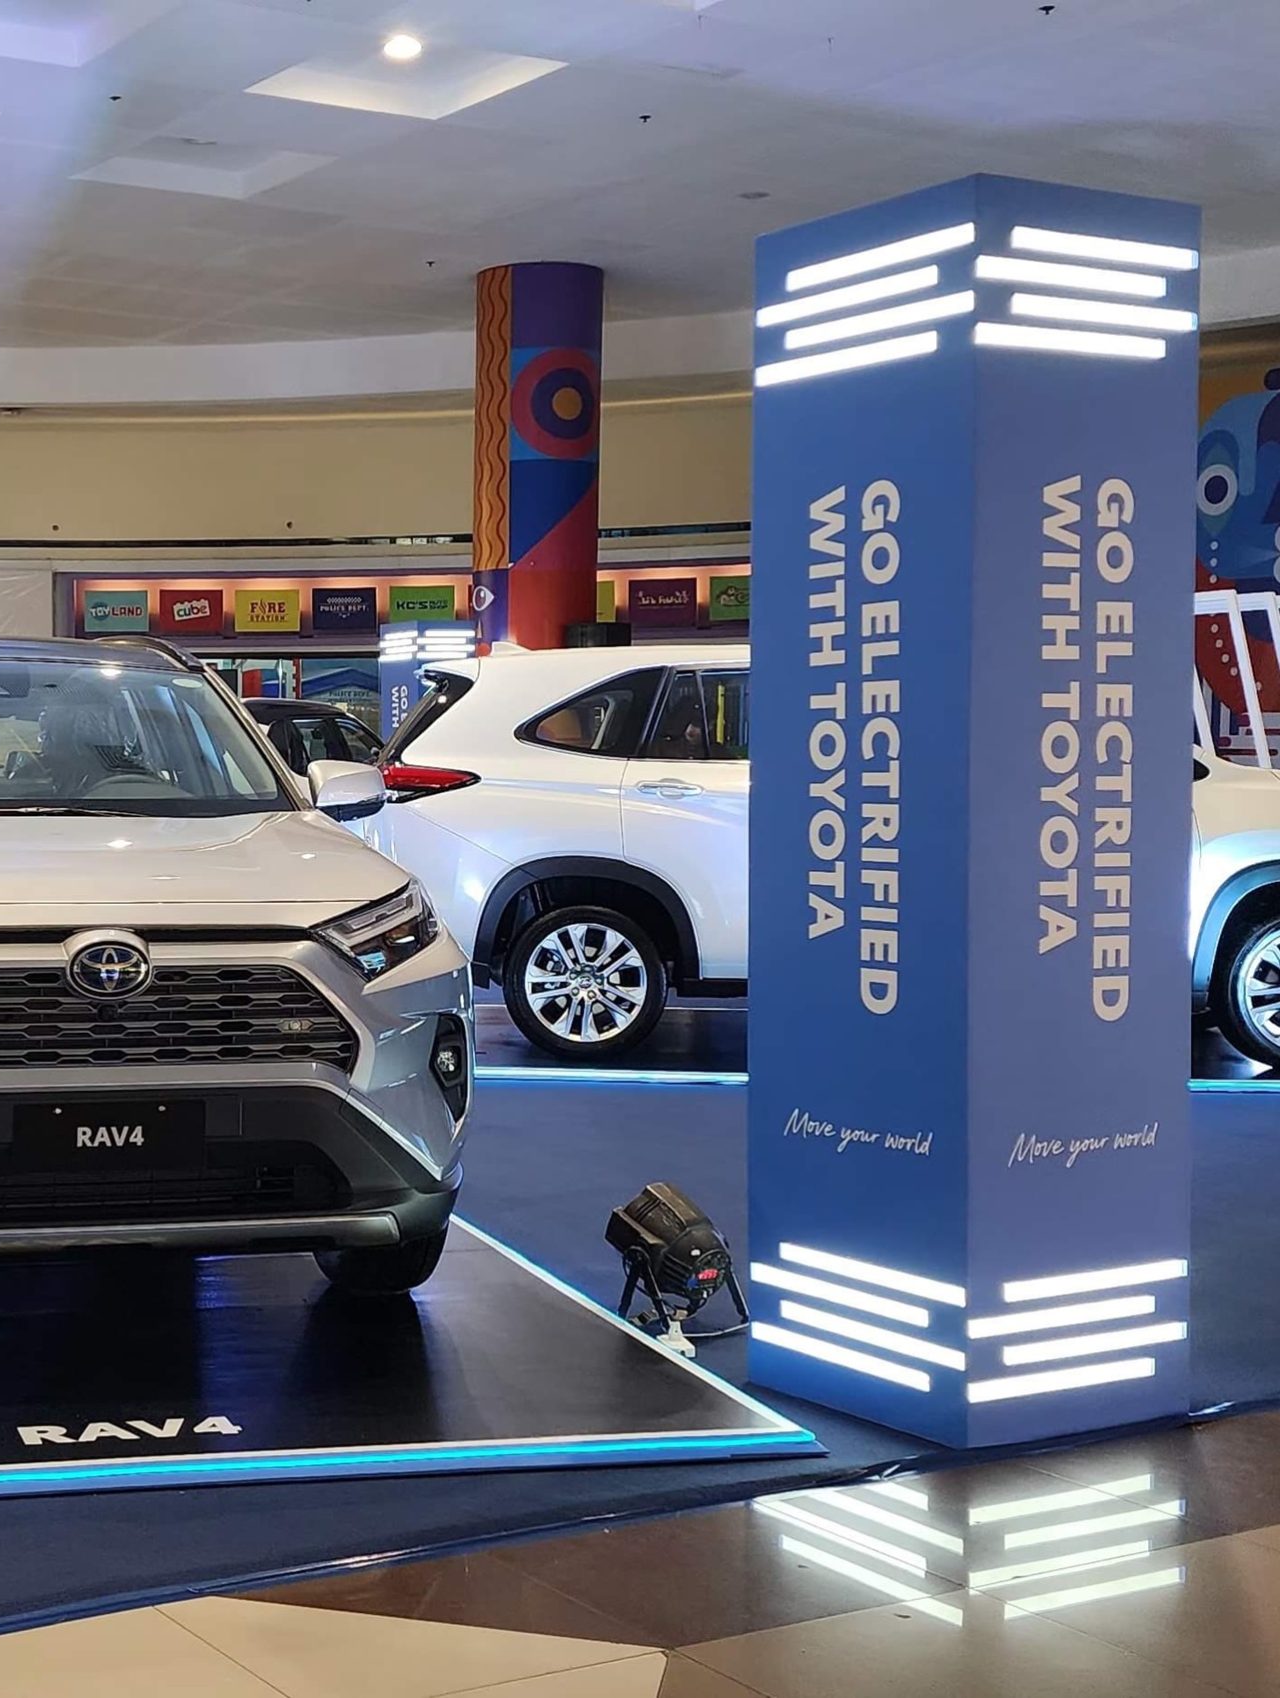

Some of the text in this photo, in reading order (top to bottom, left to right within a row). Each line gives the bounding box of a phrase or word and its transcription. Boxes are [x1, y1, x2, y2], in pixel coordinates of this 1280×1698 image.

[176, 604, 208, 618] cube
[391, 686, 400, 728] WITH
[400, 685, 409, 711] GO
[808, 485, 846, 940] WITH TOYOTA
[1038, 474, 1081, 955] WITH TOYOTA
[860, 479, 901, 1014] GO ELECTRIFIED
[1092, 478, 1135, 1022] GO ELECTRIFIED
[76, 1125, 145, 1148] RAV4
[783, 1107, 933, 1156] Move your world
[1007, 1121, 1158, 1168] Move your world
[17, 1415, 243, 1446] RAV4
